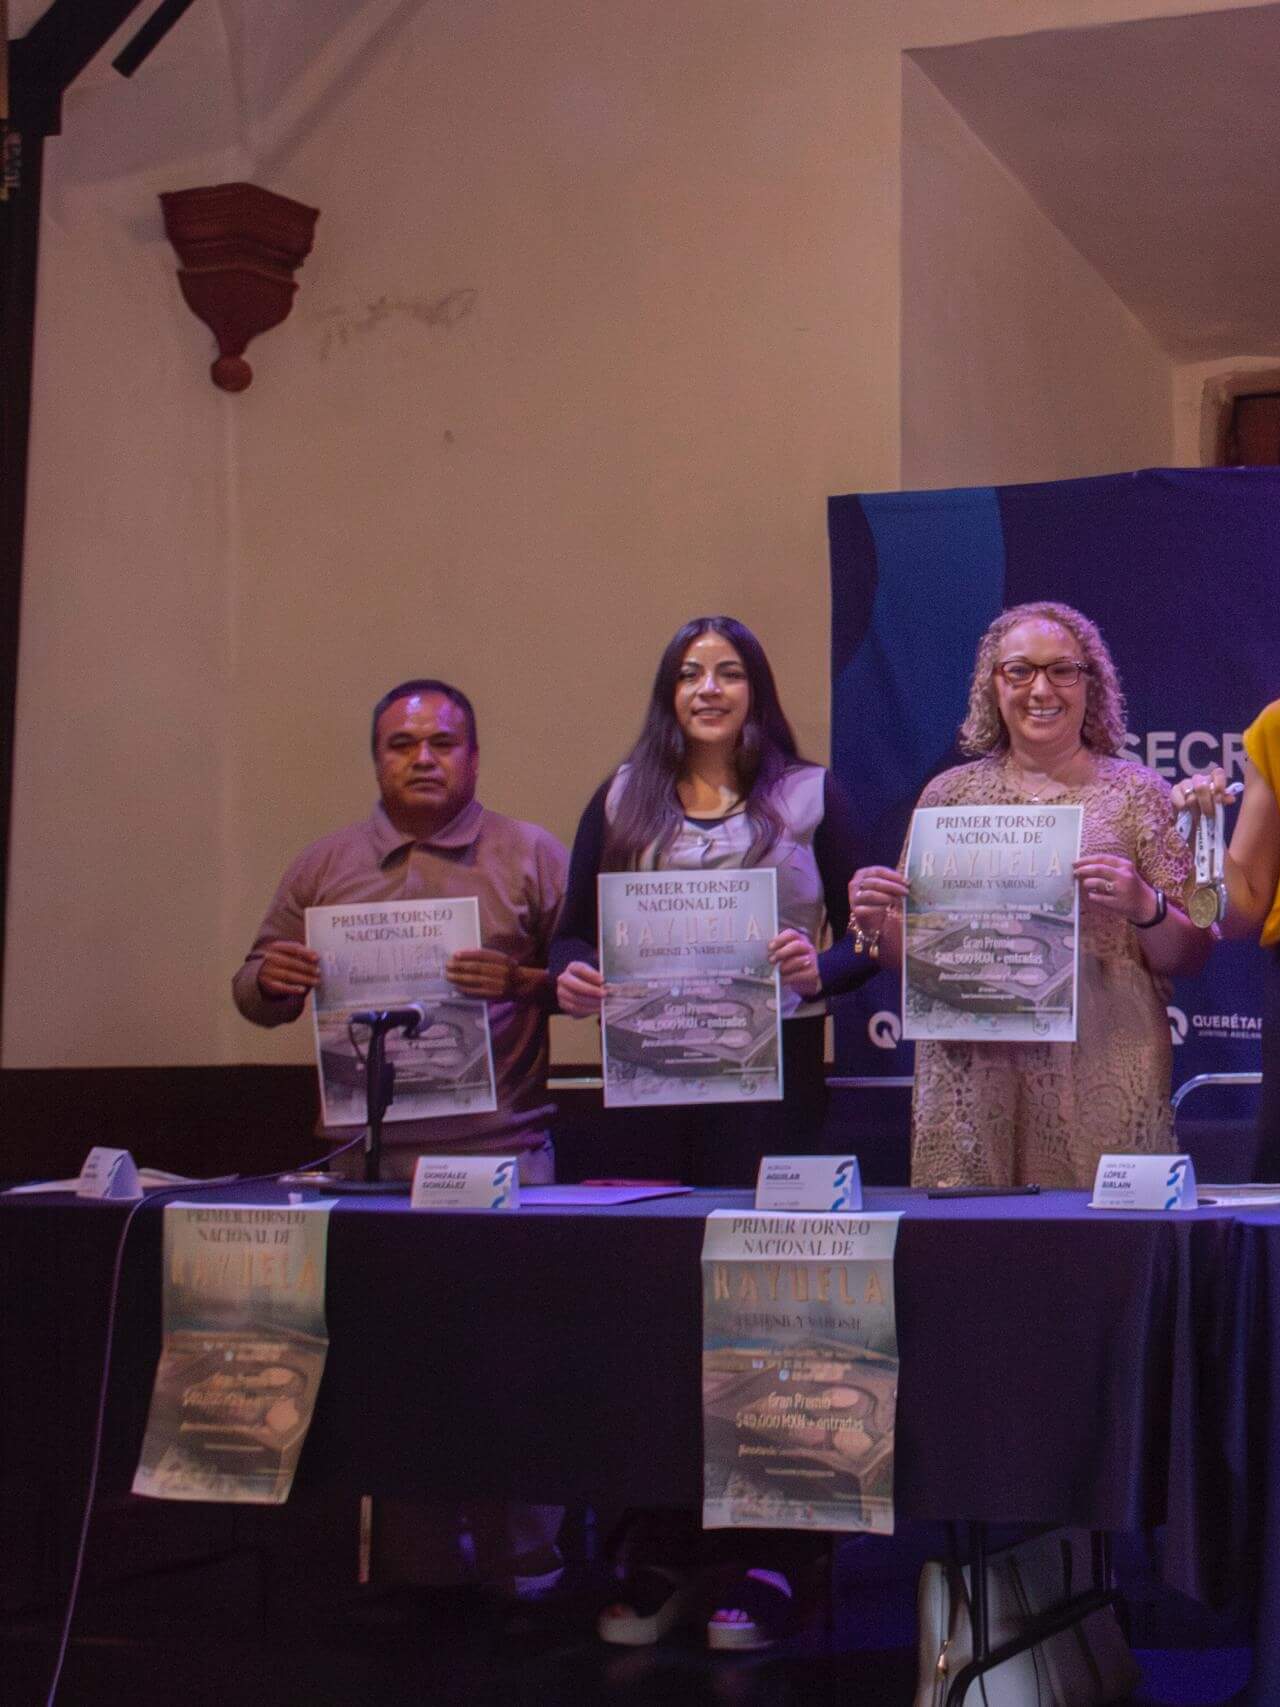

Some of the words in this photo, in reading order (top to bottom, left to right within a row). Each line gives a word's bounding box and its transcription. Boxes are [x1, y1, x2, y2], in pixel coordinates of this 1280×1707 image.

[936, 815, 992, 829] PRIMER
[995, 815, 1057, 828] TORNEO
[945, 830, 1019, 845] NACIONAL
[1023, 831, 1043, 844] DE
[920, 849, 1063, 878] RAYUELA
[625, 881, 683, 897] PRIMER
[686, 879, 750, 894] TORNEO
[638, 898, 714, 912] NACIONAL
[718, 896, 738, 909] DE
[331, 911, 389, 928] PRIMER
[392, 908, 453, 925] TORNEO
[422, 925, 443, 937] DE
[731, 1218, 795, 1234] PRIMER
[801, 1218, 871, 1235] TORNEO
[743, 1239, 827, 1256] NACIONAL
[831, 1240, 855, 1256] DE
[713, 1262, 884, 1305] RAYUELA
